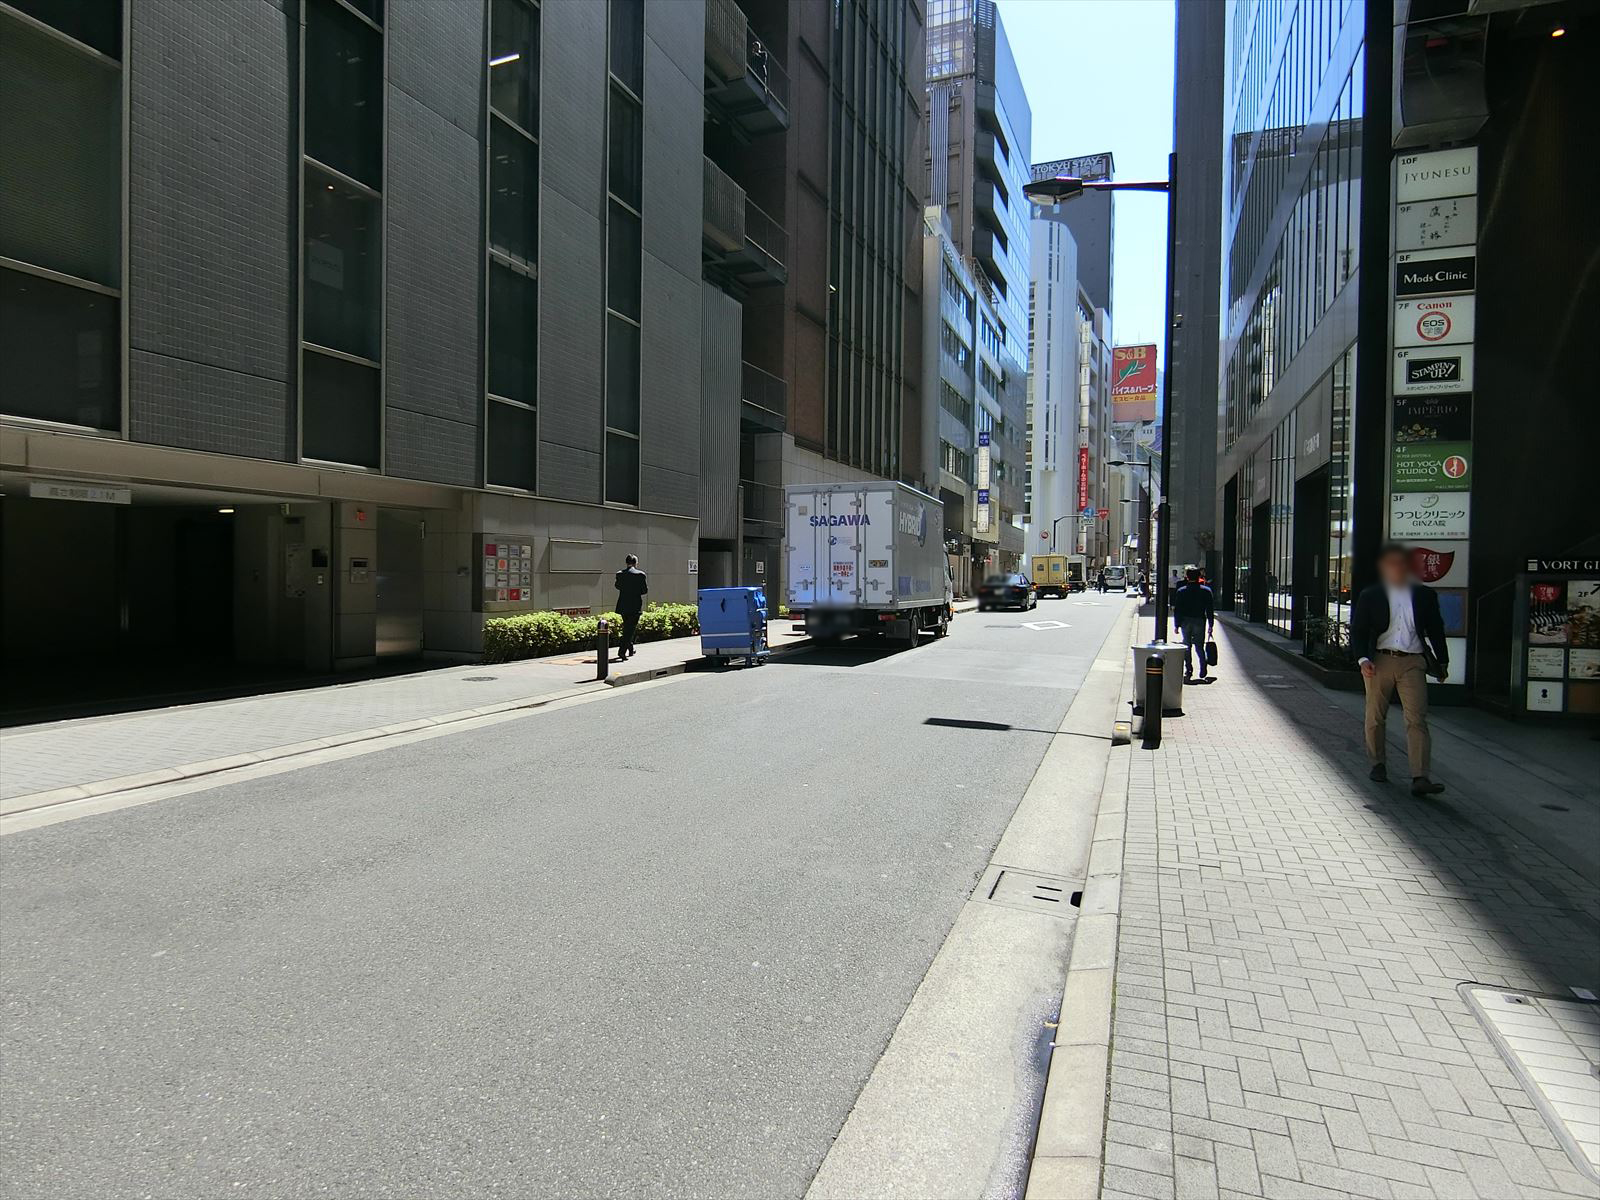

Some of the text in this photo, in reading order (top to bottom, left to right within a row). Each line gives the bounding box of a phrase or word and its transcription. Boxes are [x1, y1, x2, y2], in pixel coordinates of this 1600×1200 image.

[1036, 156, 1099, 174] TOKYU STAY
[1401, 157, 1418, 165] 10F
[1405, 166, 1471, 184] JYUNESU
[1399, 254, 1411, 262] 8F
[1403, 270, 1468, 284] Mods Clinic
[1416, 301, 1452, 311] Canon
[1422, 319, 1445, 327] EOS
[1114, 347, 1146, 361] S&B
[1397, 351, 1409, 359] 6F
[1408, 405, 1458, 416] IMPERIO
[1417, 460, 1442, 468] YOGA
[1394, 510, 1466, 520] つつじクリニック
[809, 514, 871, 527] SAGAWA
[1541, 560, 1580, 570] VORT
